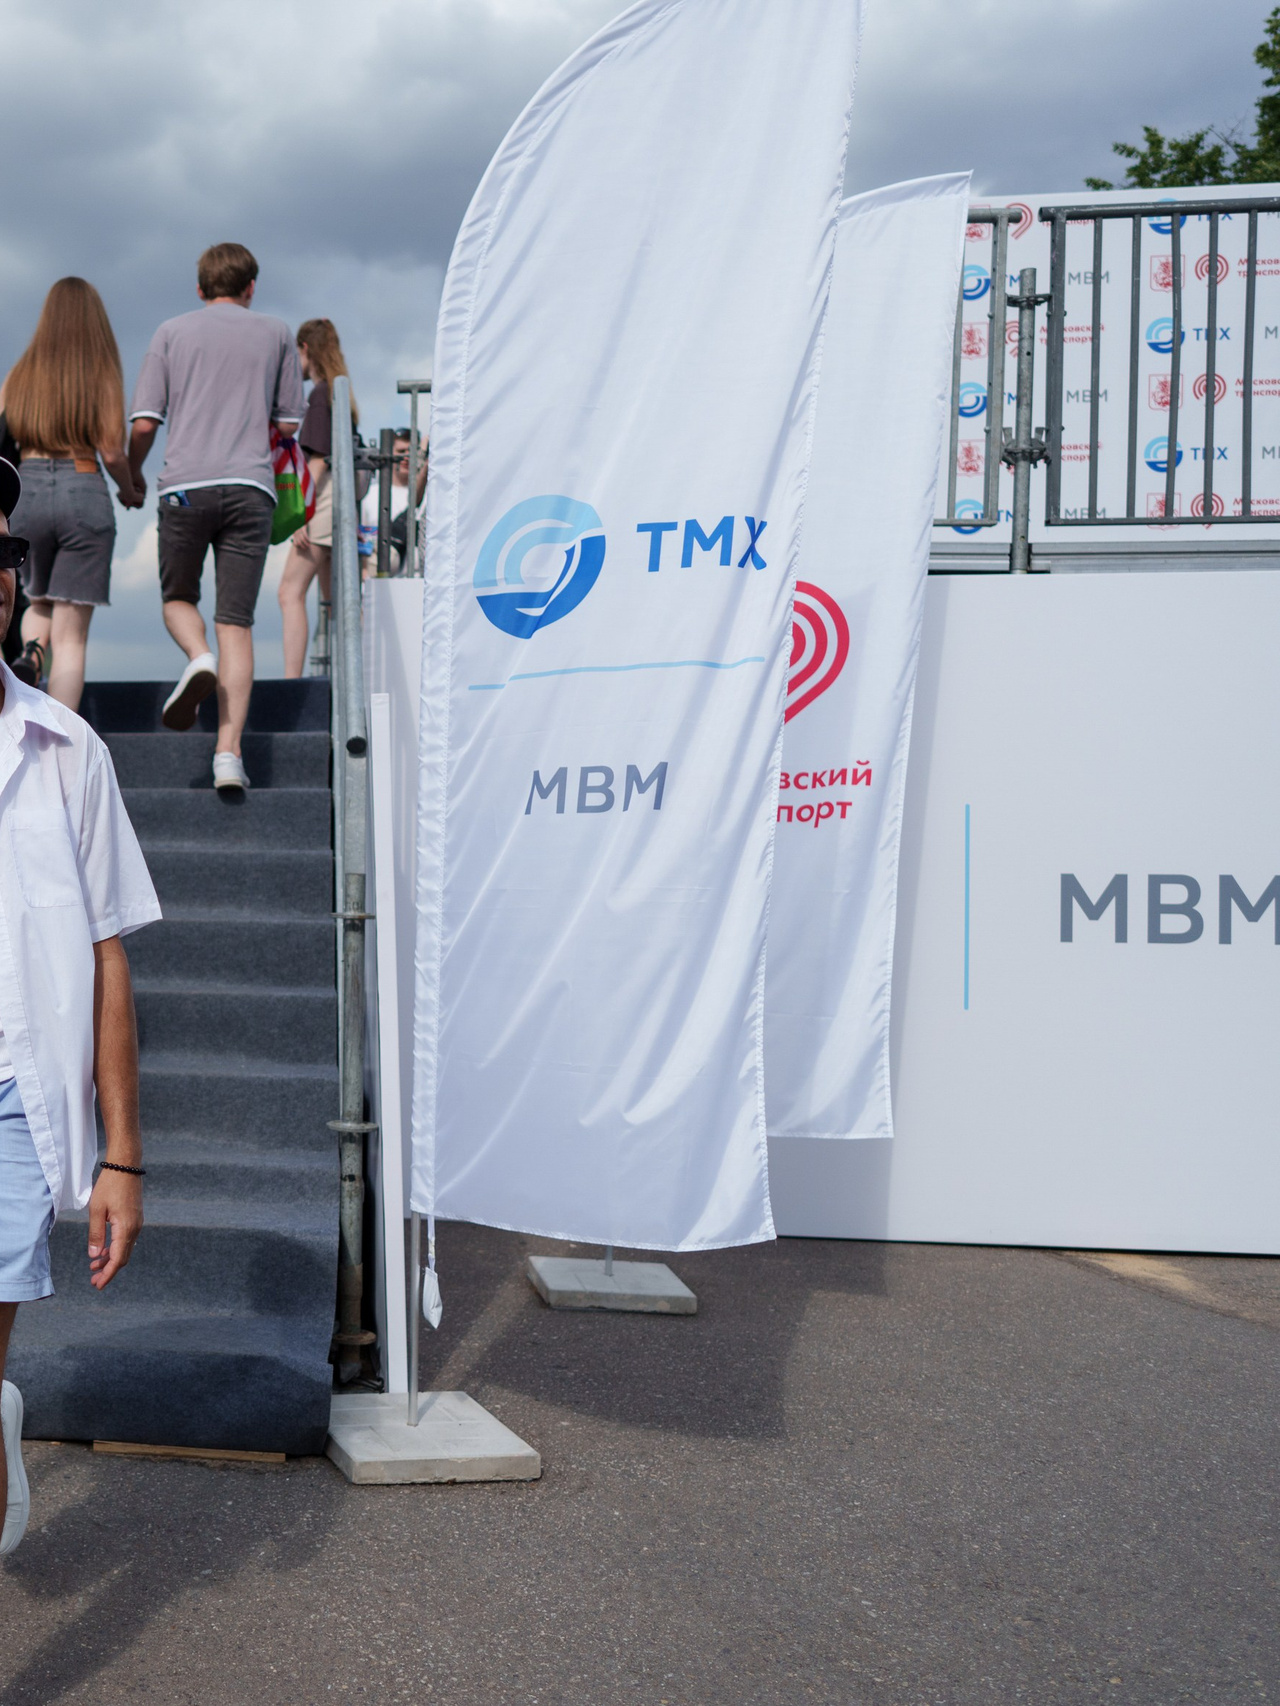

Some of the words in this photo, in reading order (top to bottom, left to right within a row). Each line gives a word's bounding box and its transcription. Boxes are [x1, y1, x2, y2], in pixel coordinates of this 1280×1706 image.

[1238, 258, 1280, 266] Мсков
[1237, 269, 1280, 278] трнспо
[1235, 377, 1280, 386] Мсковс
[1232, 497, 1280, 506] Мсковс
[636, 515, 768, 573] ТМХ
[779, 760, 873, 791] вский
[524, 761, 669, 816] МВМ
[1060, 873, 1280, 946] МВМ
